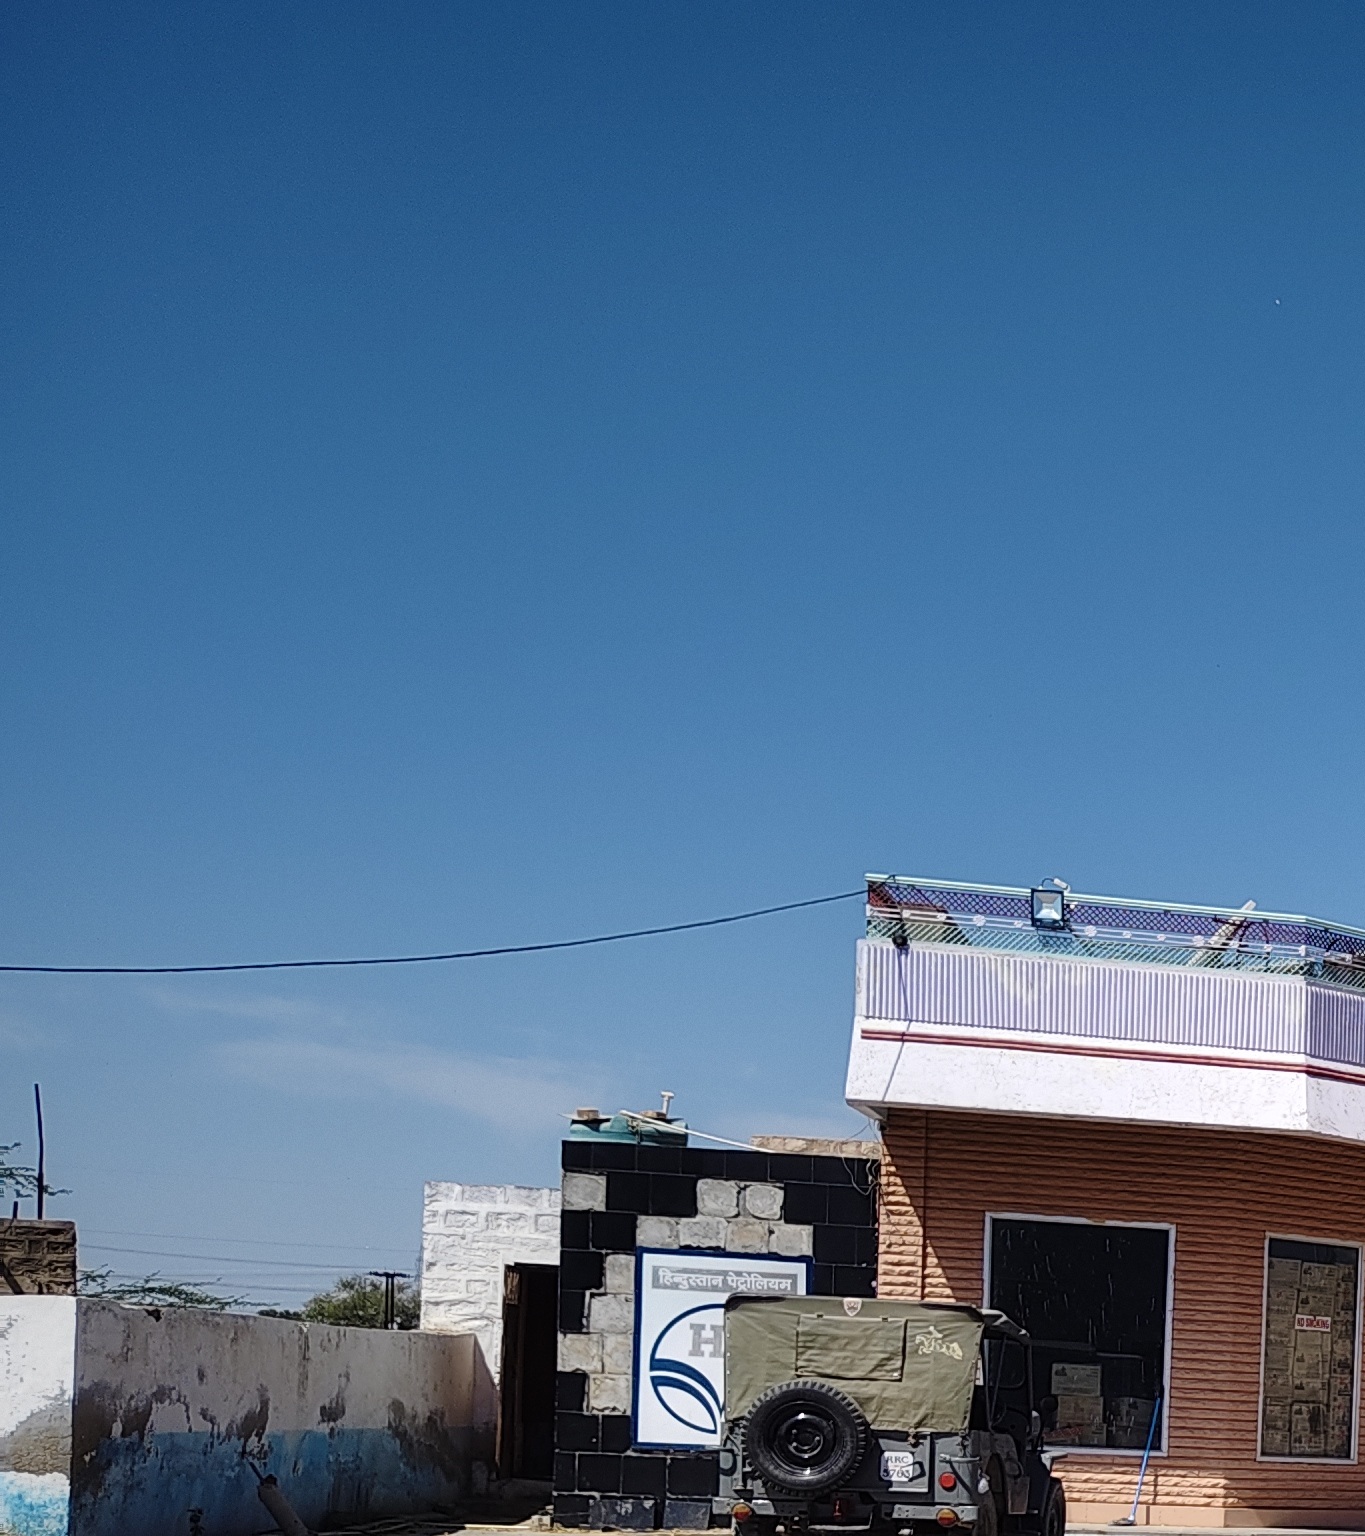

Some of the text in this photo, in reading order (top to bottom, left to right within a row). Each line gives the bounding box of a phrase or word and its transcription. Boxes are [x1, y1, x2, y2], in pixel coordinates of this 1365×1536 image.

[658, 1268, 793, 1292] हिन्दुस्तान पेट्रोलियम
[1297, 1317, 1330, 1330] NO SMOKING
[688, 1322, 725, 1358] H
